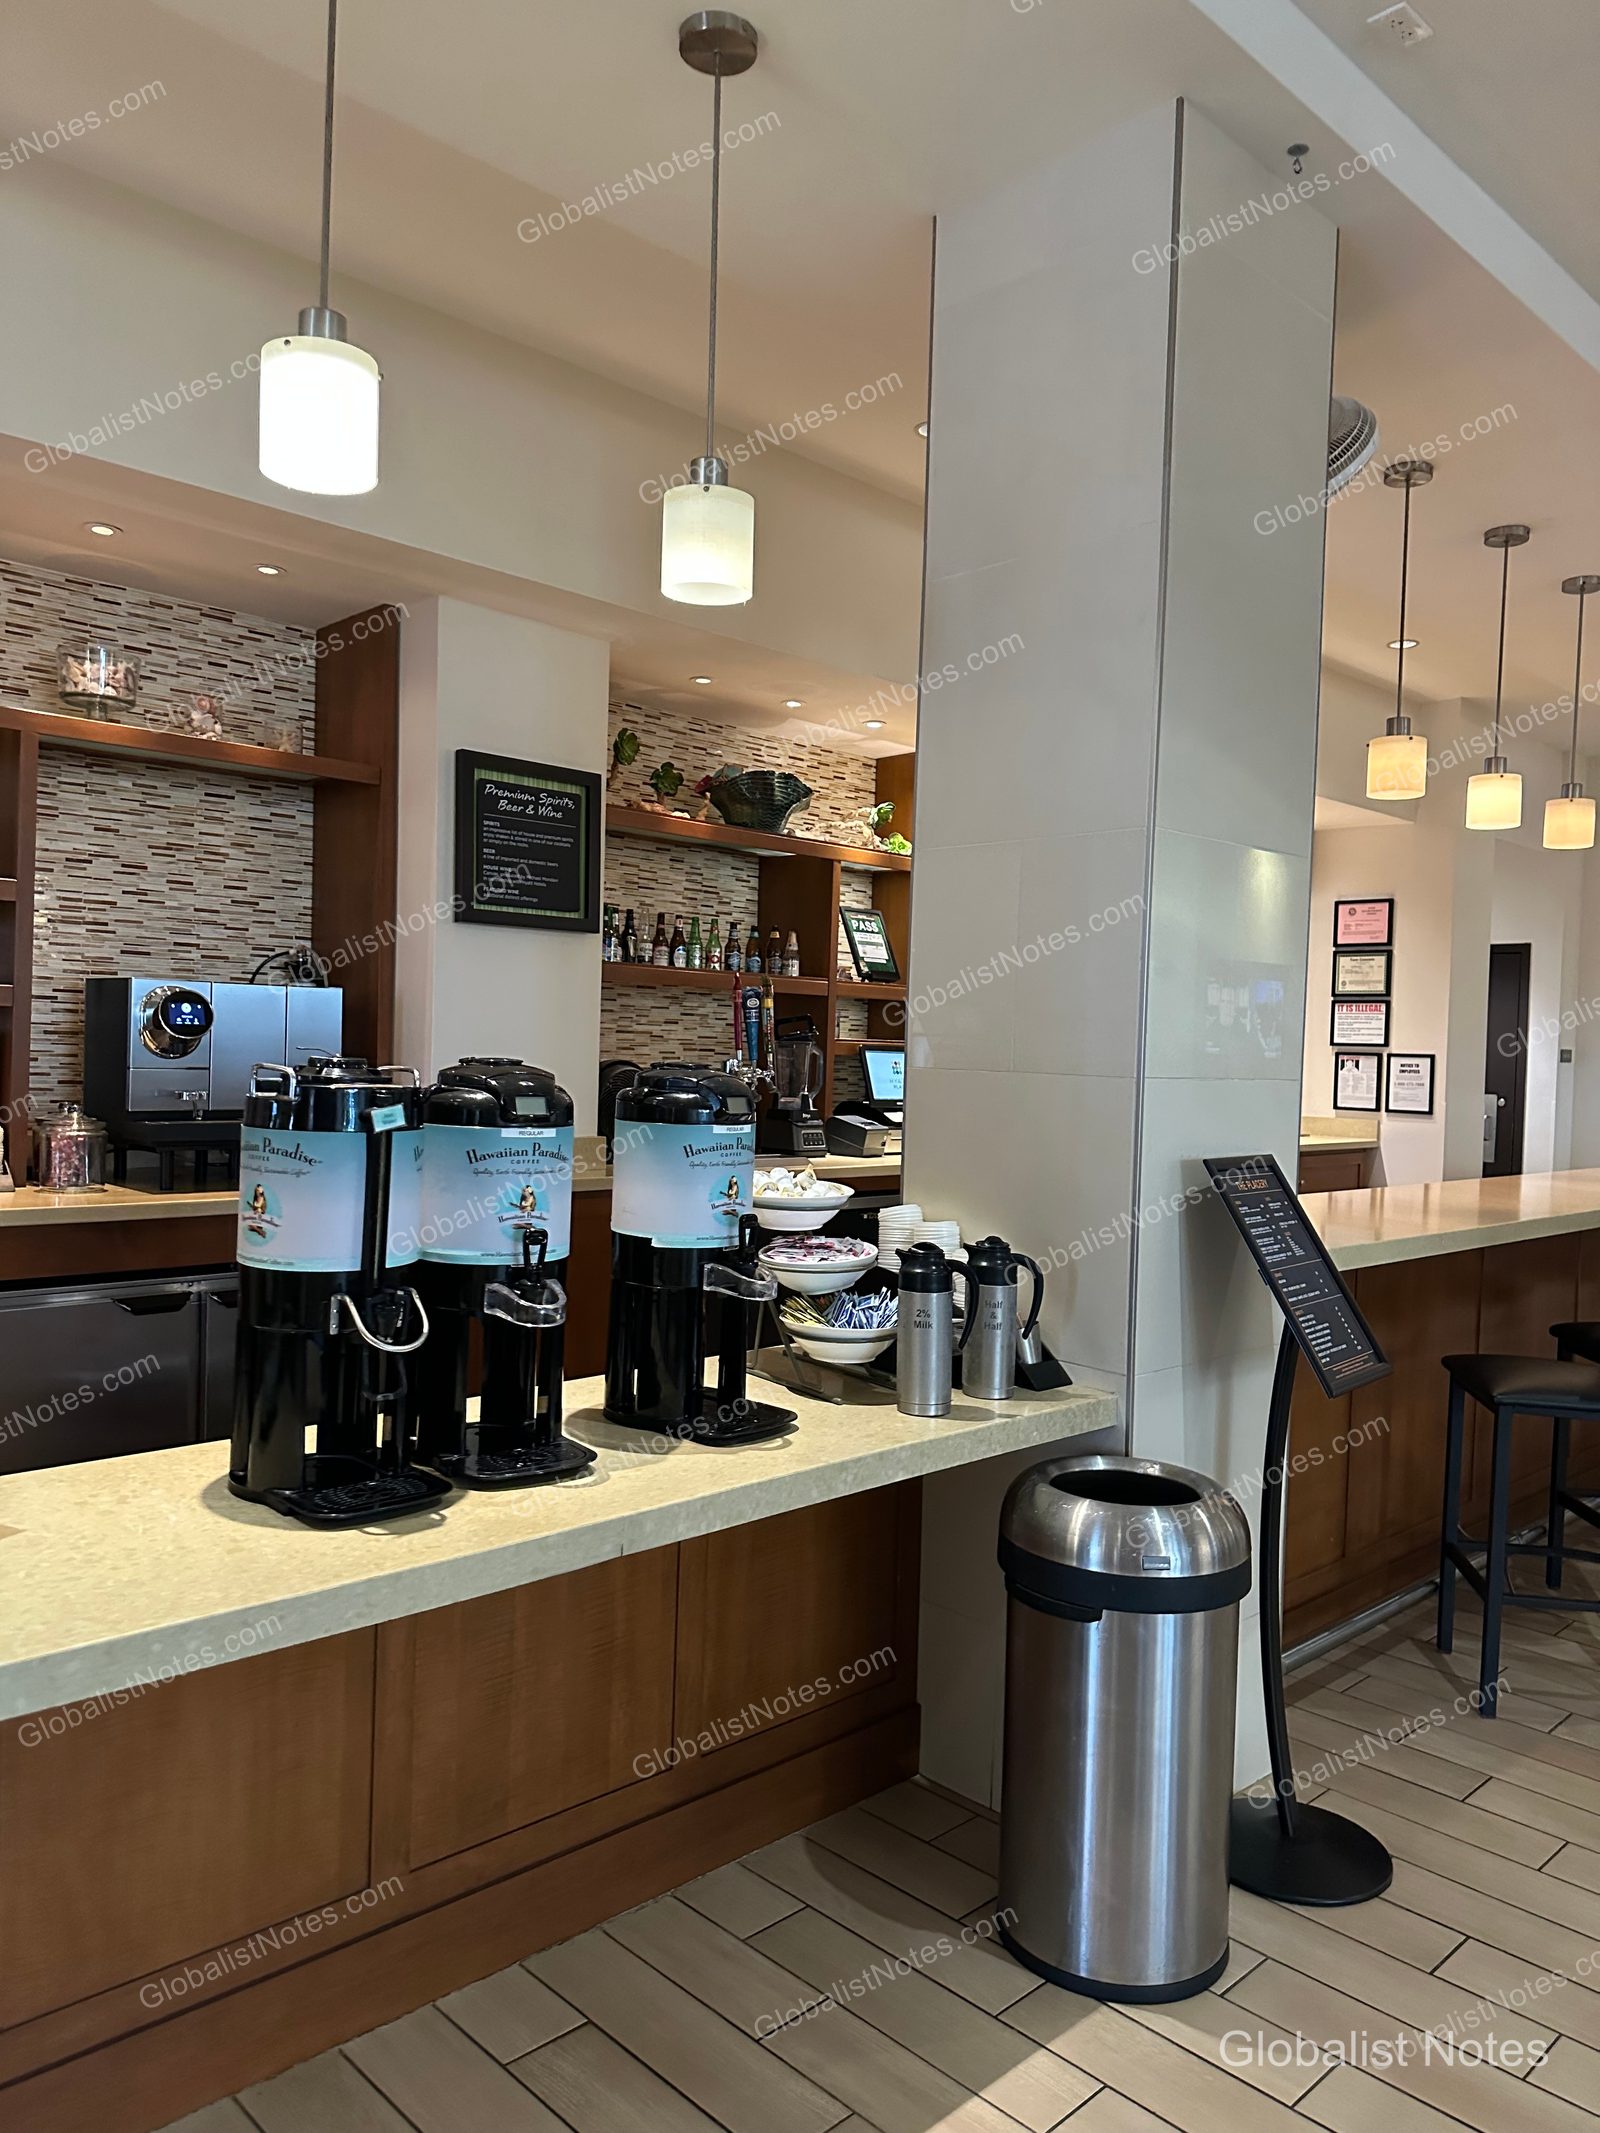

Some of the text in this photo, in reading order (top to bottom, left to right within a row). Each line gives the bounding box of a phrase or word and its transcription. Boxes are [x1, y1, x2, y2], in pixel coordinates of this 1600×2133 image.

[484, 784, 575, 809] Premium Spirits,
[497, 800, 563, 818] Beer & Wine
[851, 919, 879, 932] PASS
[1337, 1004, 1344, 1012] IT
[1346, 1004, 1353, 1012] IS
[263, 1137, 317, 1166] Paradise
[466, 1147, 528, 1164] Hawaiian
[683, 1142, 734, 1158] Hawaiian
[984, 1301, 1003, 1309] Half
[915, 1309, 931, 1319] 2%
[914, 1320, 933, 1329] Milk
[984, 1322, 1003, 1331] Half
